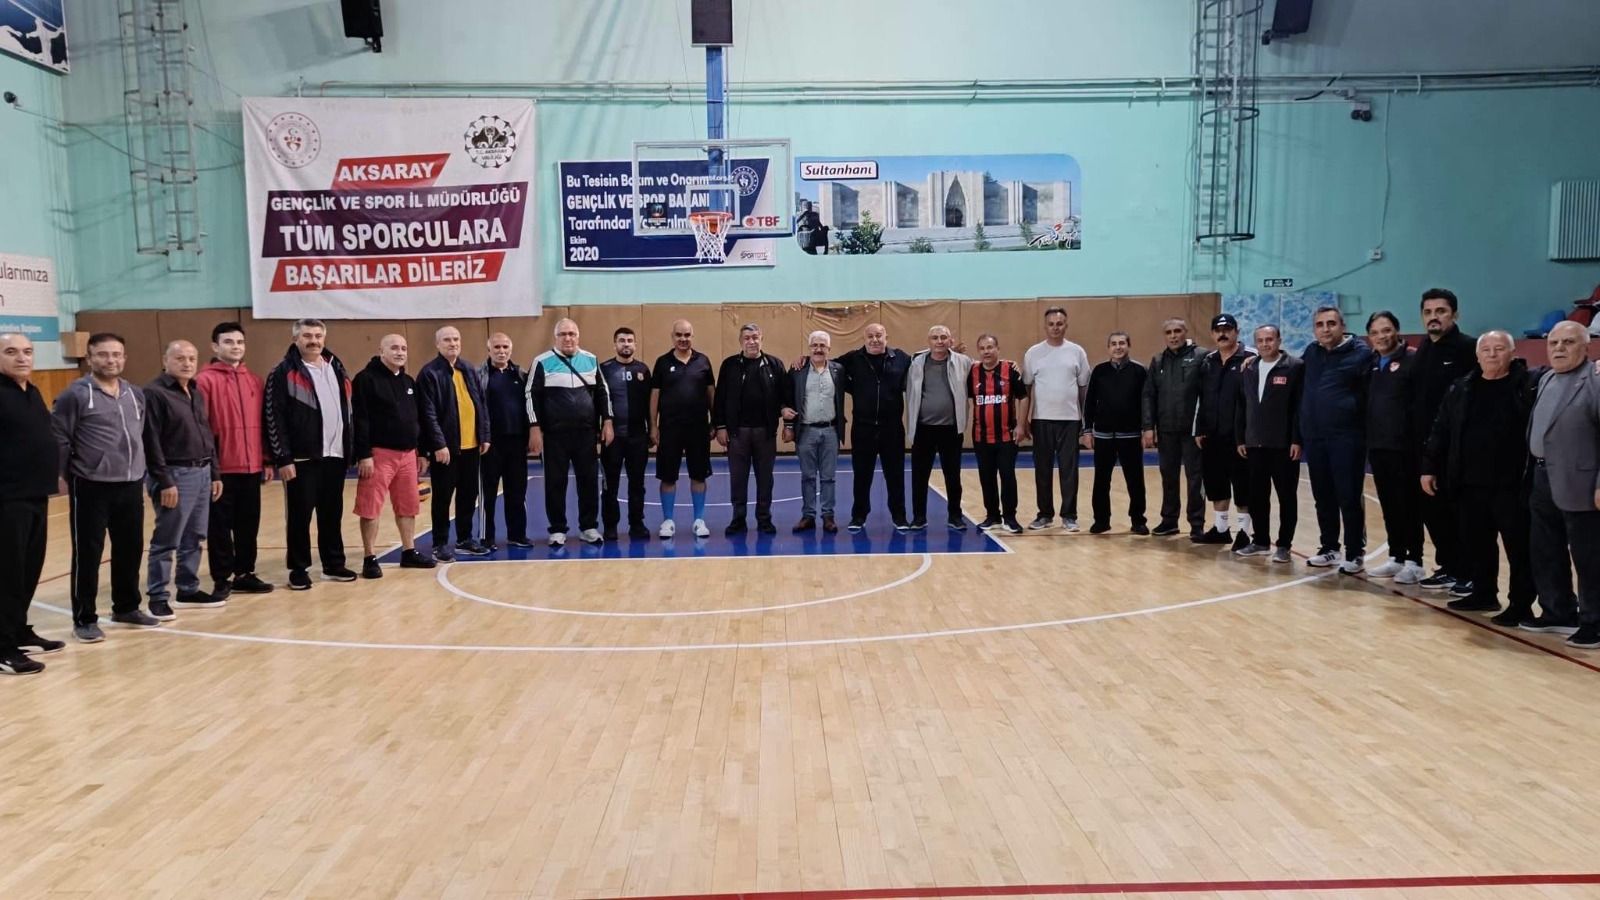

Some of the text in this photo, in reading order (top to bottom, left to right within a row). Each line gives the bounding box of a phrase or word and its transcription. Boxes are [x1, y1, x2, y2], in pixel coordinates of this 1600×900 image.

[338, 162, 436, 182] AKSARAY
[805, 164, 872, 175] Sultanhanı
[566, 175, 581, 188] Bu
[582, 173, 619, 187] Tesisin
[656, 176, 669, 186] ve
[271, 187, 521, 214] GENÇLİK VE SPOR İL MÜDÜRLÜĞÜ
[567, 191, 617, 213] GENÇLİK
[618, 194, 633, 209] VE
[756, 216, 780, 227] TBF
[280, 217, 507, 251] TÜM SPORCULARA
[569, 236, 587, 244] Ekim
[570, 246, 599, 261] 2020
[285, 256, 486, 290] BAŞARILAR DİLERİZ
